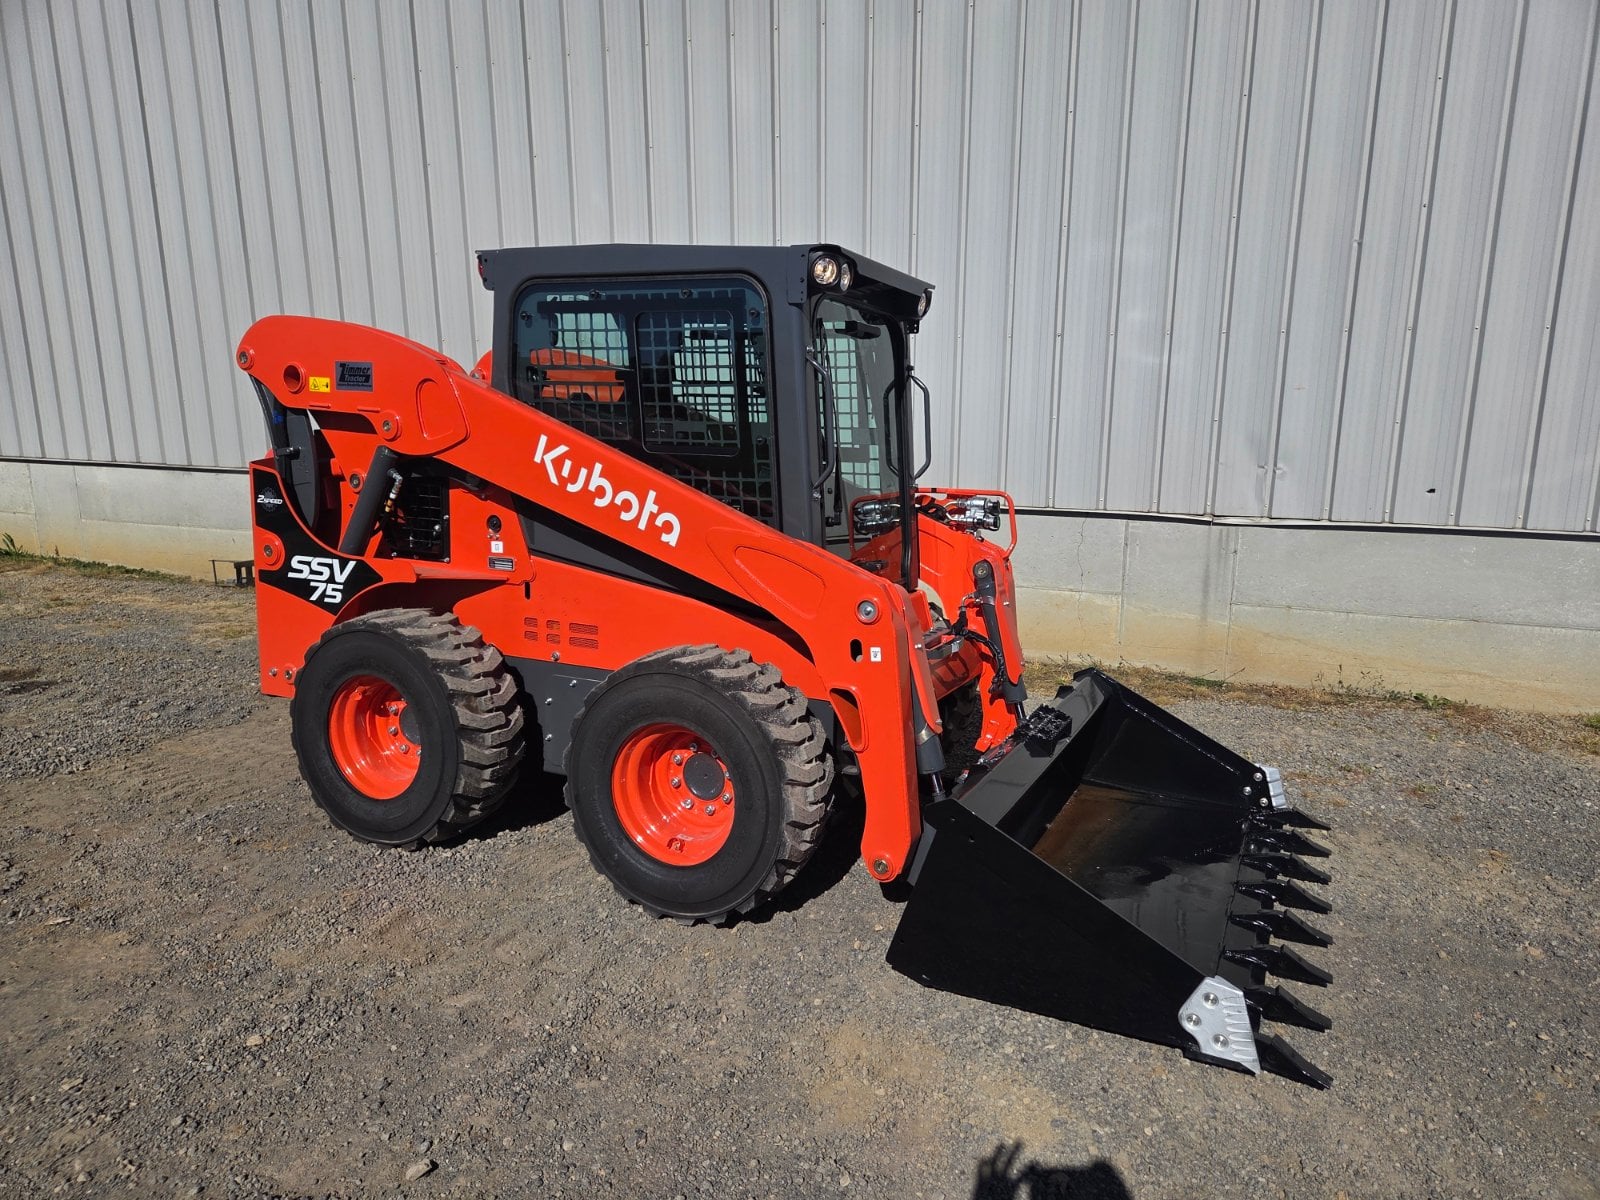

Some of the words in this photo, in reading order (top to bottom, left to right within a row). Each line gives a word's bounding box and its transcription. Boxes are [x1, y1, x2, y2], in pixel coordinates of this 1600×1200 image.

[339, 362, 371, 376] Zimmer
[533, 433, 681, 548] Kubota
[287, 555, 357, 583] SSV
[309, 581, 344, 603] 75
